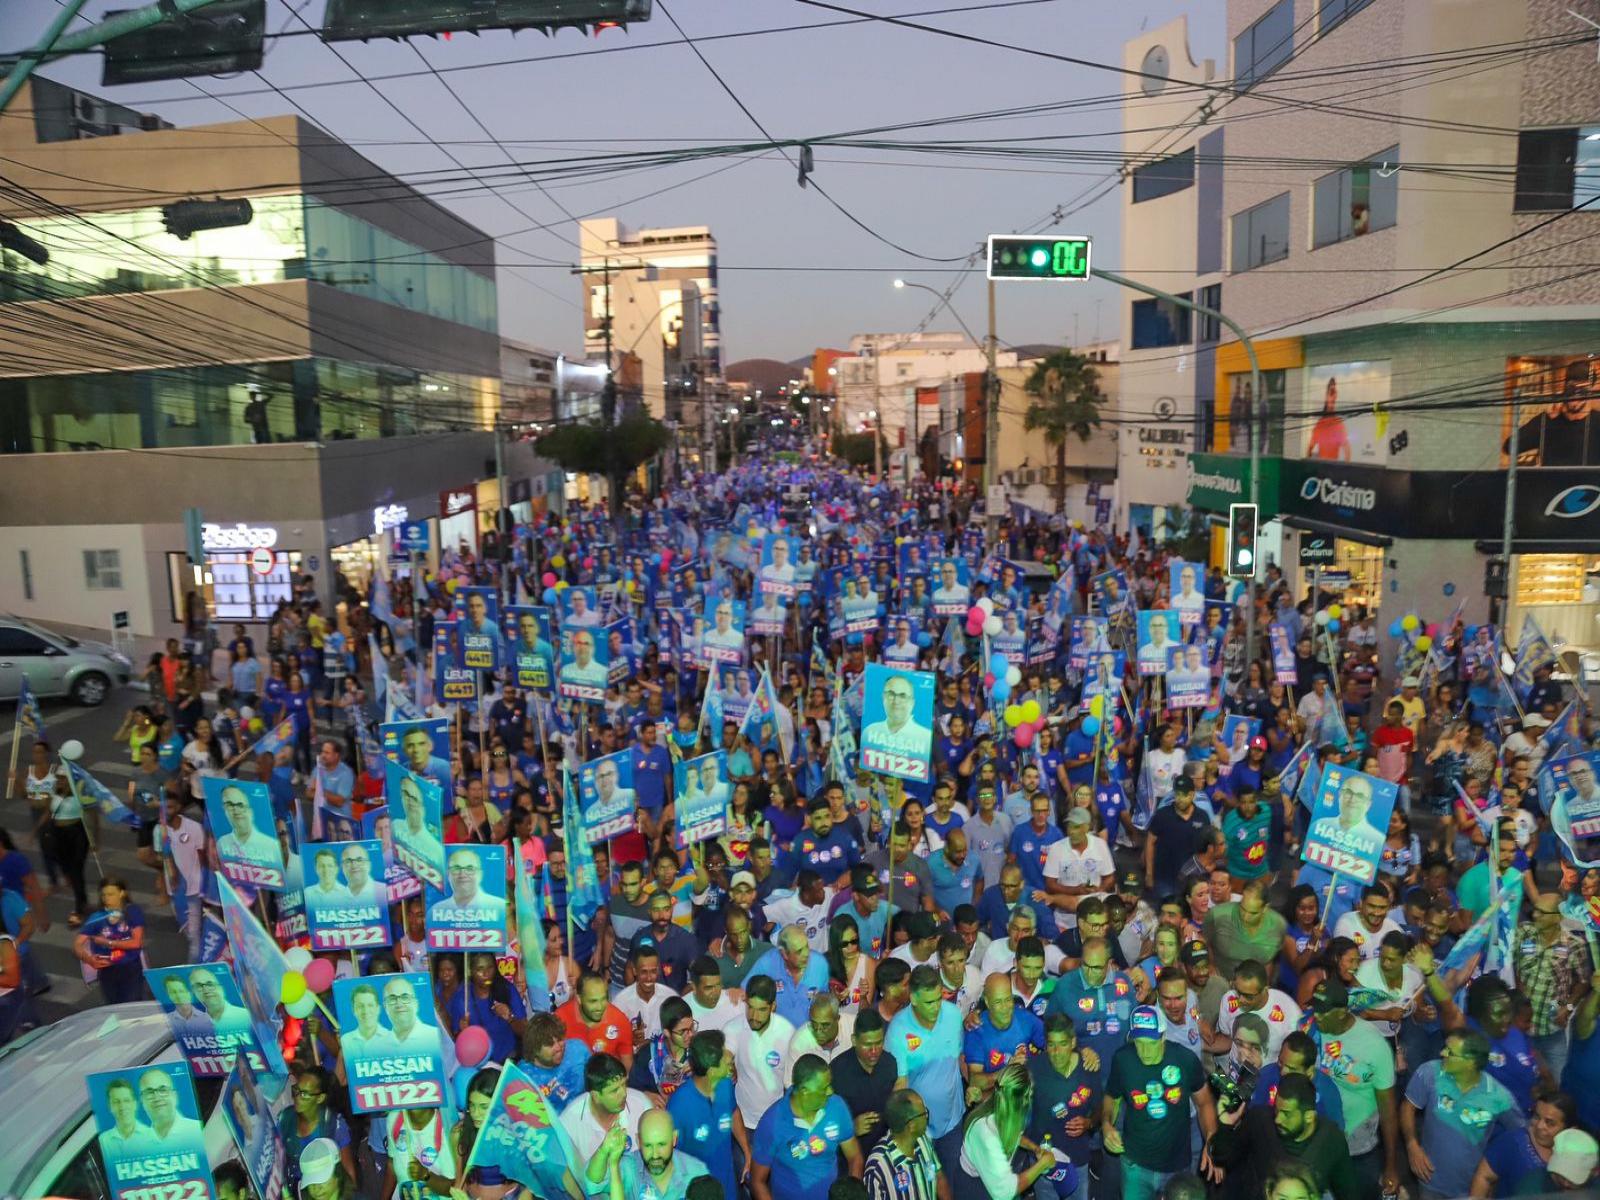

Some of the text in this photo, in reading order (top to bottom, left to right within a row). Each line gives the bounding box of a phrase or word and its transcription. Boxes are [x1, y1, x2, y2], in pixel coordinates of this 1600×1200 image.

[1320, 478, 1376, 510] Carisma
[1301, 546, 1333, 557] Carisma
[867, 731, 925, 754] HASSAN
[865, 750, 925, 778] 11122
[586, 800, 629, 822] HASSAN
[585, 815, 633, 842] 11122
[1315, 823, 1375, 854] HASSAN
[1308, 842, 1372, 880] 11122
[224, 863, 284, 886] 11122
[315, 907, 380, 922] HASSAN
[432, 909, 498, 921] HASSAN
[316, 926, 384, 946] 11122
[431, 930, 502, 947] 11122
[183, 1032, 253, 1049] HASSAN
[355, 1056, 433, 1078] HASSAN
[358, 1081, 441, 1108] 11122
[115, 1153, 200, 1181] HASSAN
[120, 1181, 209, 1200] 11122
